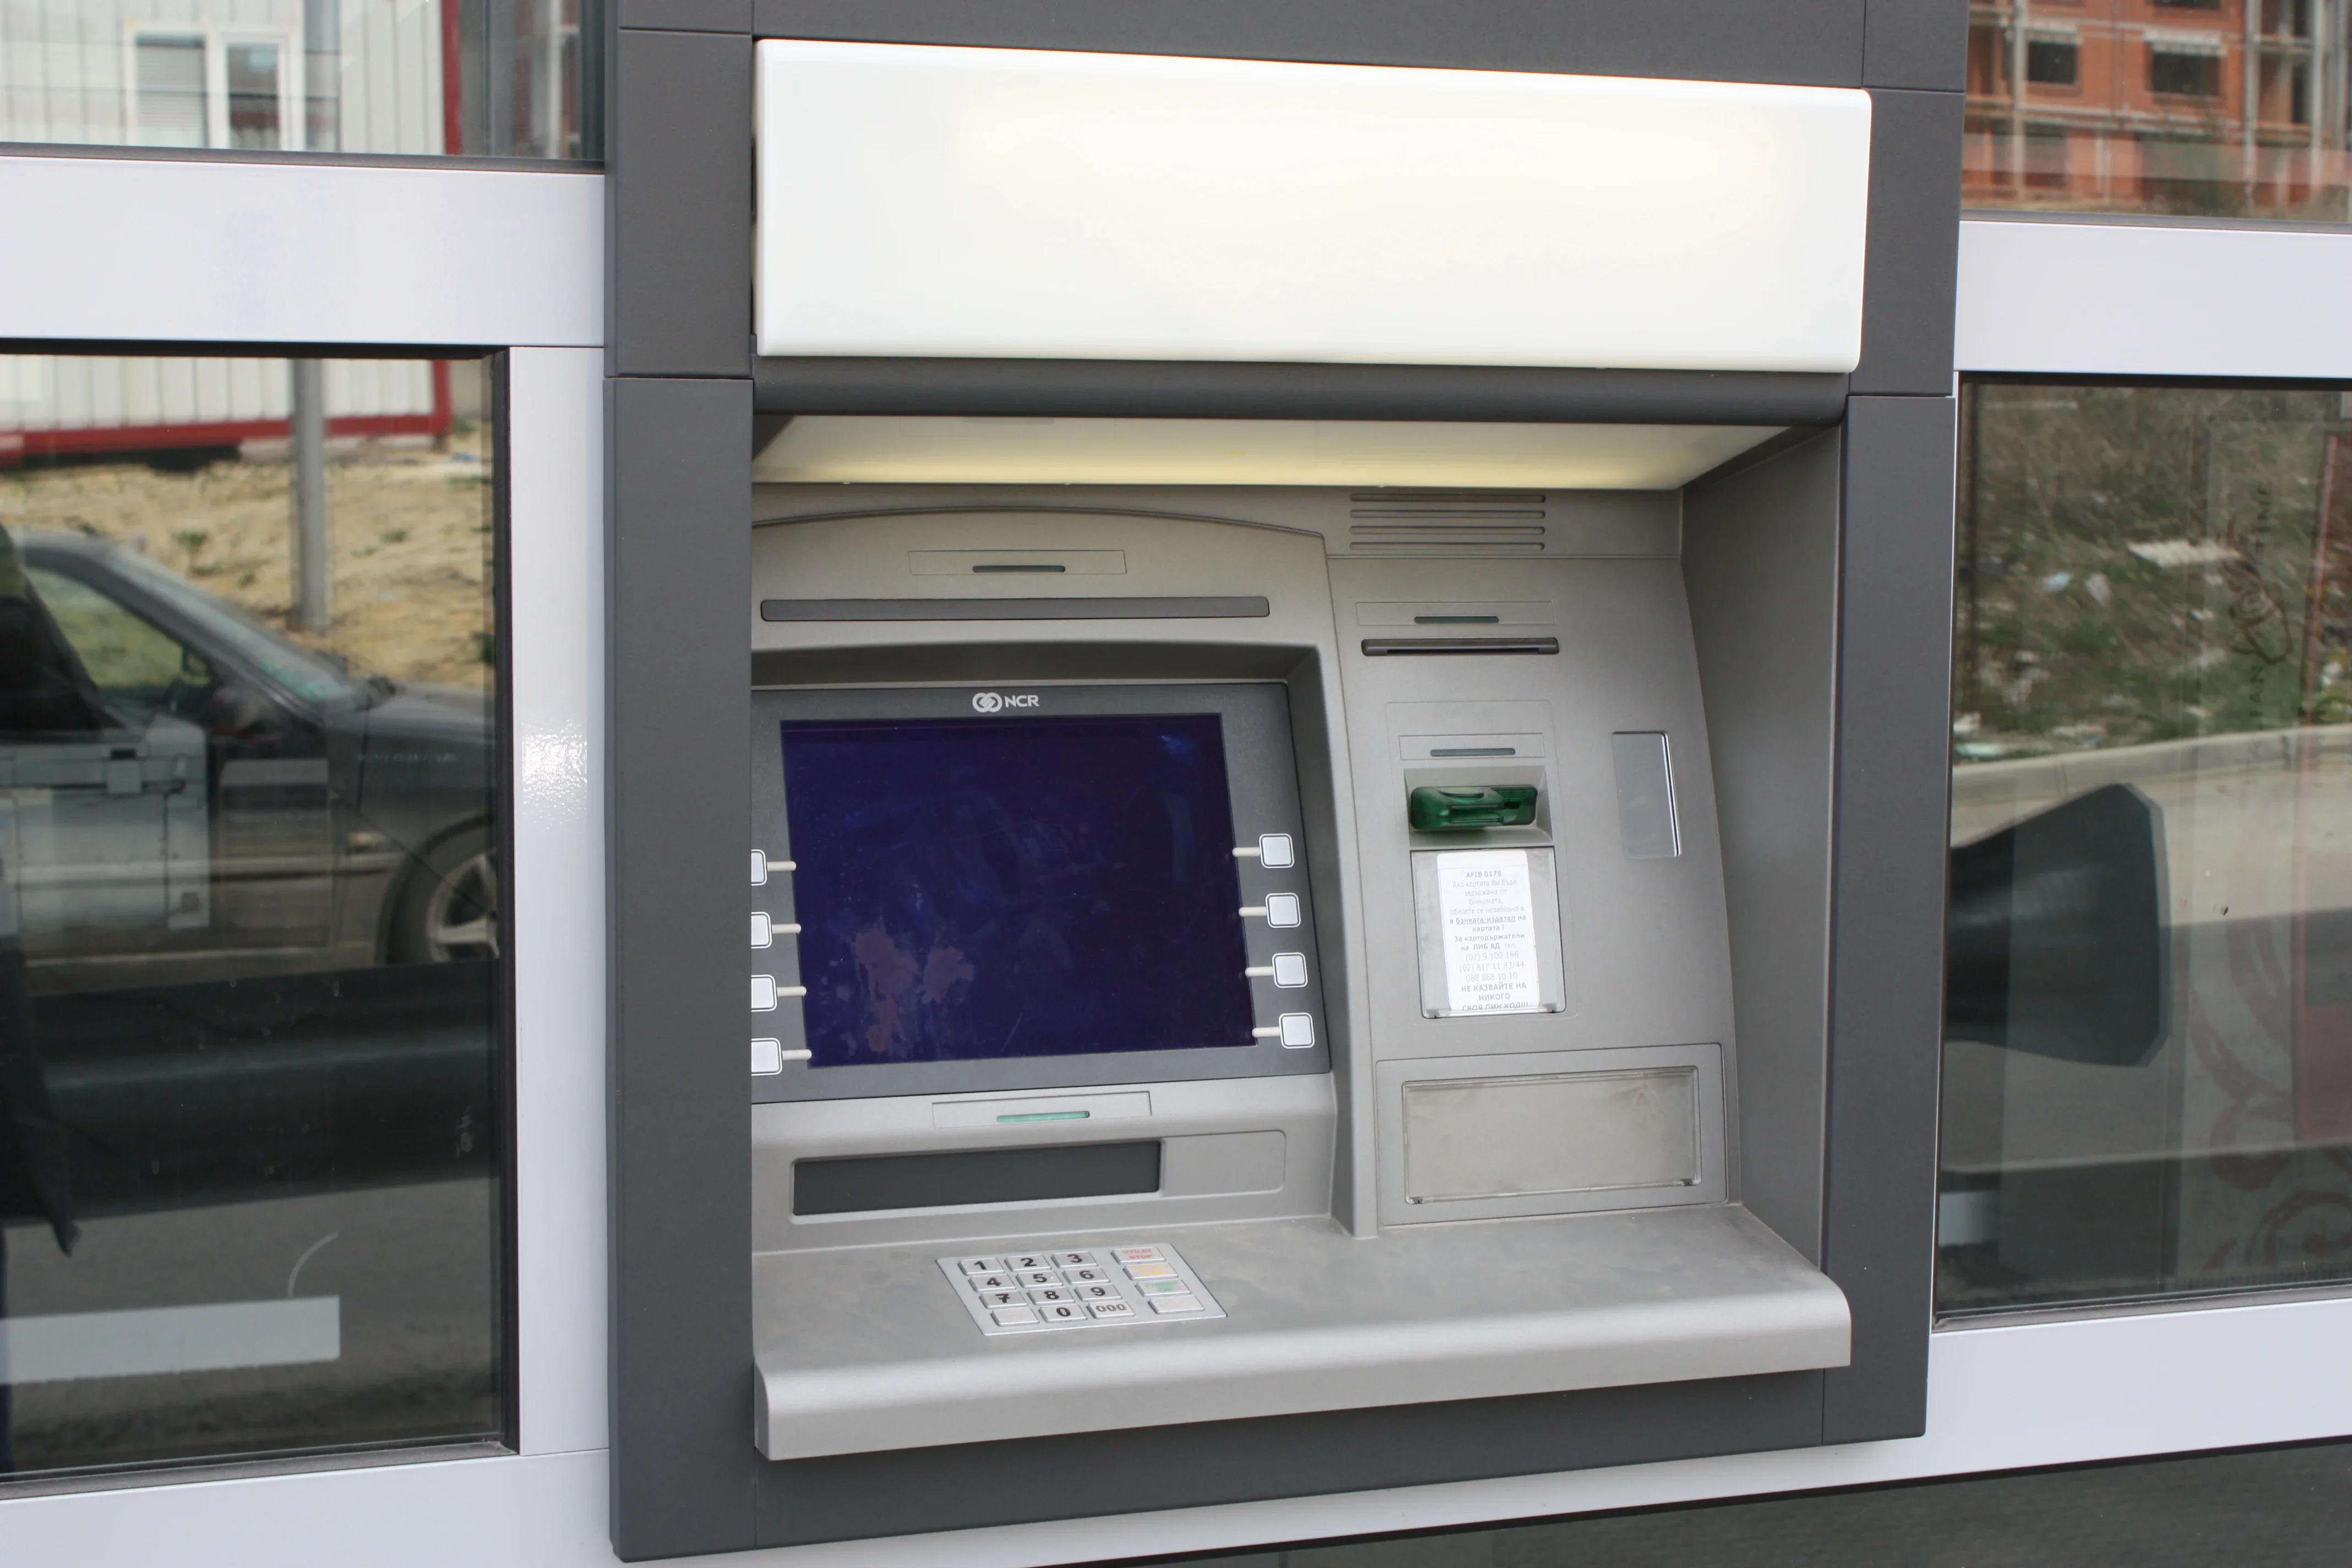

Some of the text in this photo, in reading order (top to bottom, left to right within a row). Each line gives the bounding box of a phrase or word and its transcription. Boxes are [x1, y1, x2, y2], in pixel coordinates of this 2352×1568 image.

[1004, 695, 1039, 707] NCR
[1473, 982, 1513, 992] КАЗВАЙТЕ
[973, 1254, 1082, 1270] 1 2 3
[987, 1270, 1095, 1286] 4 5 6
[995, 1287, 1106, 1303] 7 8 9
[1056, 1307, 1071, 1316] 0
